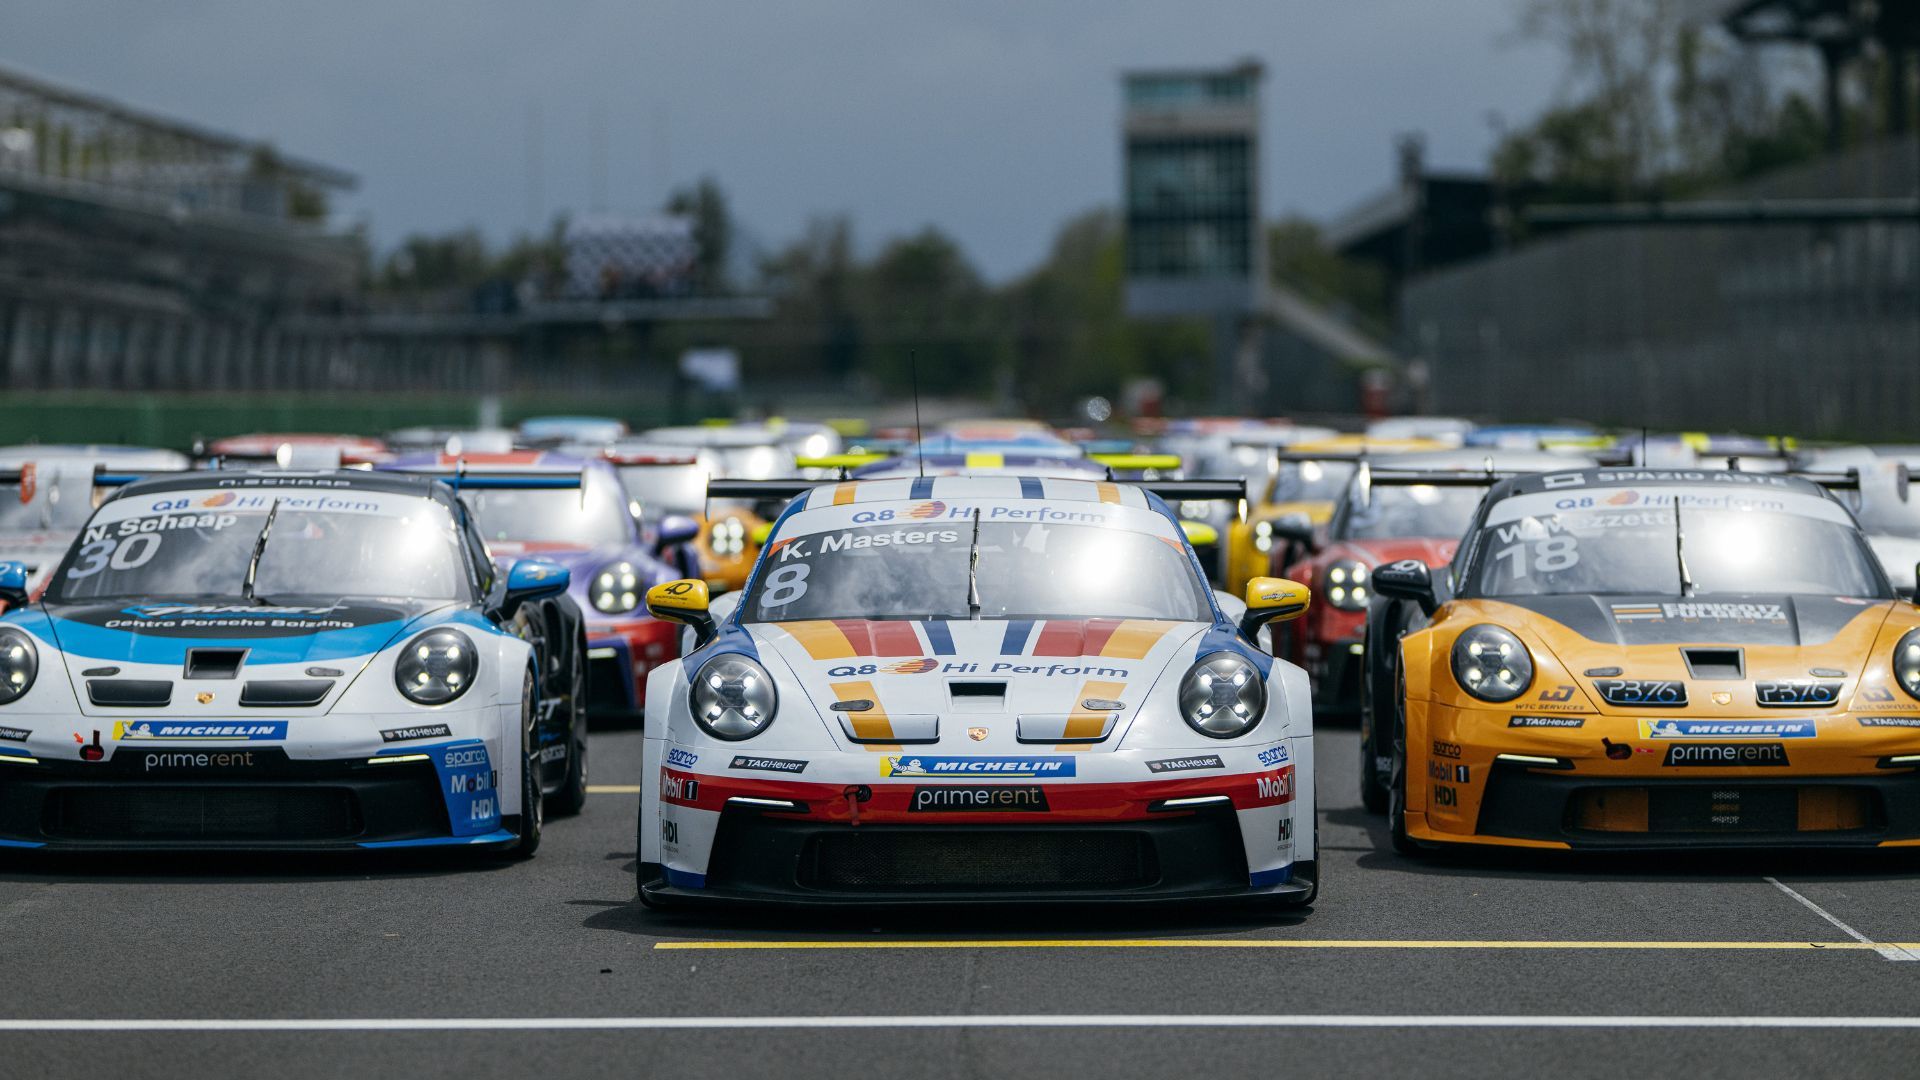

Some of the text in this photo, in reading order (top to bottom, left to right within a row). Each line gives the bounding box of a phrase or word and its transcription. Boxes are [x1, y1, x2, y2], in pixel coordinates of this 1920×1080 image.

[1598, 472, 1788, 487] SPAZIO ASTE
[151, 495, 379, 513] Q8 Hi Perform
[1555, 495, 1785, 511] Q8 Hi Perform
[851, 506, 1107, 524] Q8 Hi Perform
[82, 511, 238, 546] N. Schaap
[779, 528, 959, 563] K. Masters
[67, 532, 163, 580] 30
[1495, 535, 1580, 580] 18
[664, 582, 694, 595] 40
[760, 562, 811, 609] 8
[105, 618, 355, 630] Centro Porsche Bolzano
[827, 662, 1130, 679] Q8 Hi Perform
[159, 725, 276, 735] MICHELIN
[1688, 724, 1804, 734] MICHELIN
[145, 751, 254, 771] primerent
[445, 748, 486, 766] sparco
[668, 748, 699, 766] sparco
[1257, 745, 1288, 765] sparco
[1671, 744, 1781, 764] primerent
[933, 762, 1063, 771] MICHELIN
[451, 772, 490, 795] Mobil
[662, 771, 684, 799] Mobil
[1256, 773, 1289, 799] Mobil
[917, 786, 1040, 810] primerent
[1434, 784, 1458, 807] HDI
[470, 796, 495, 821] HDI
[662, 818, 679, 844] HDI
[1277, 817, 1294, 842] HDI
